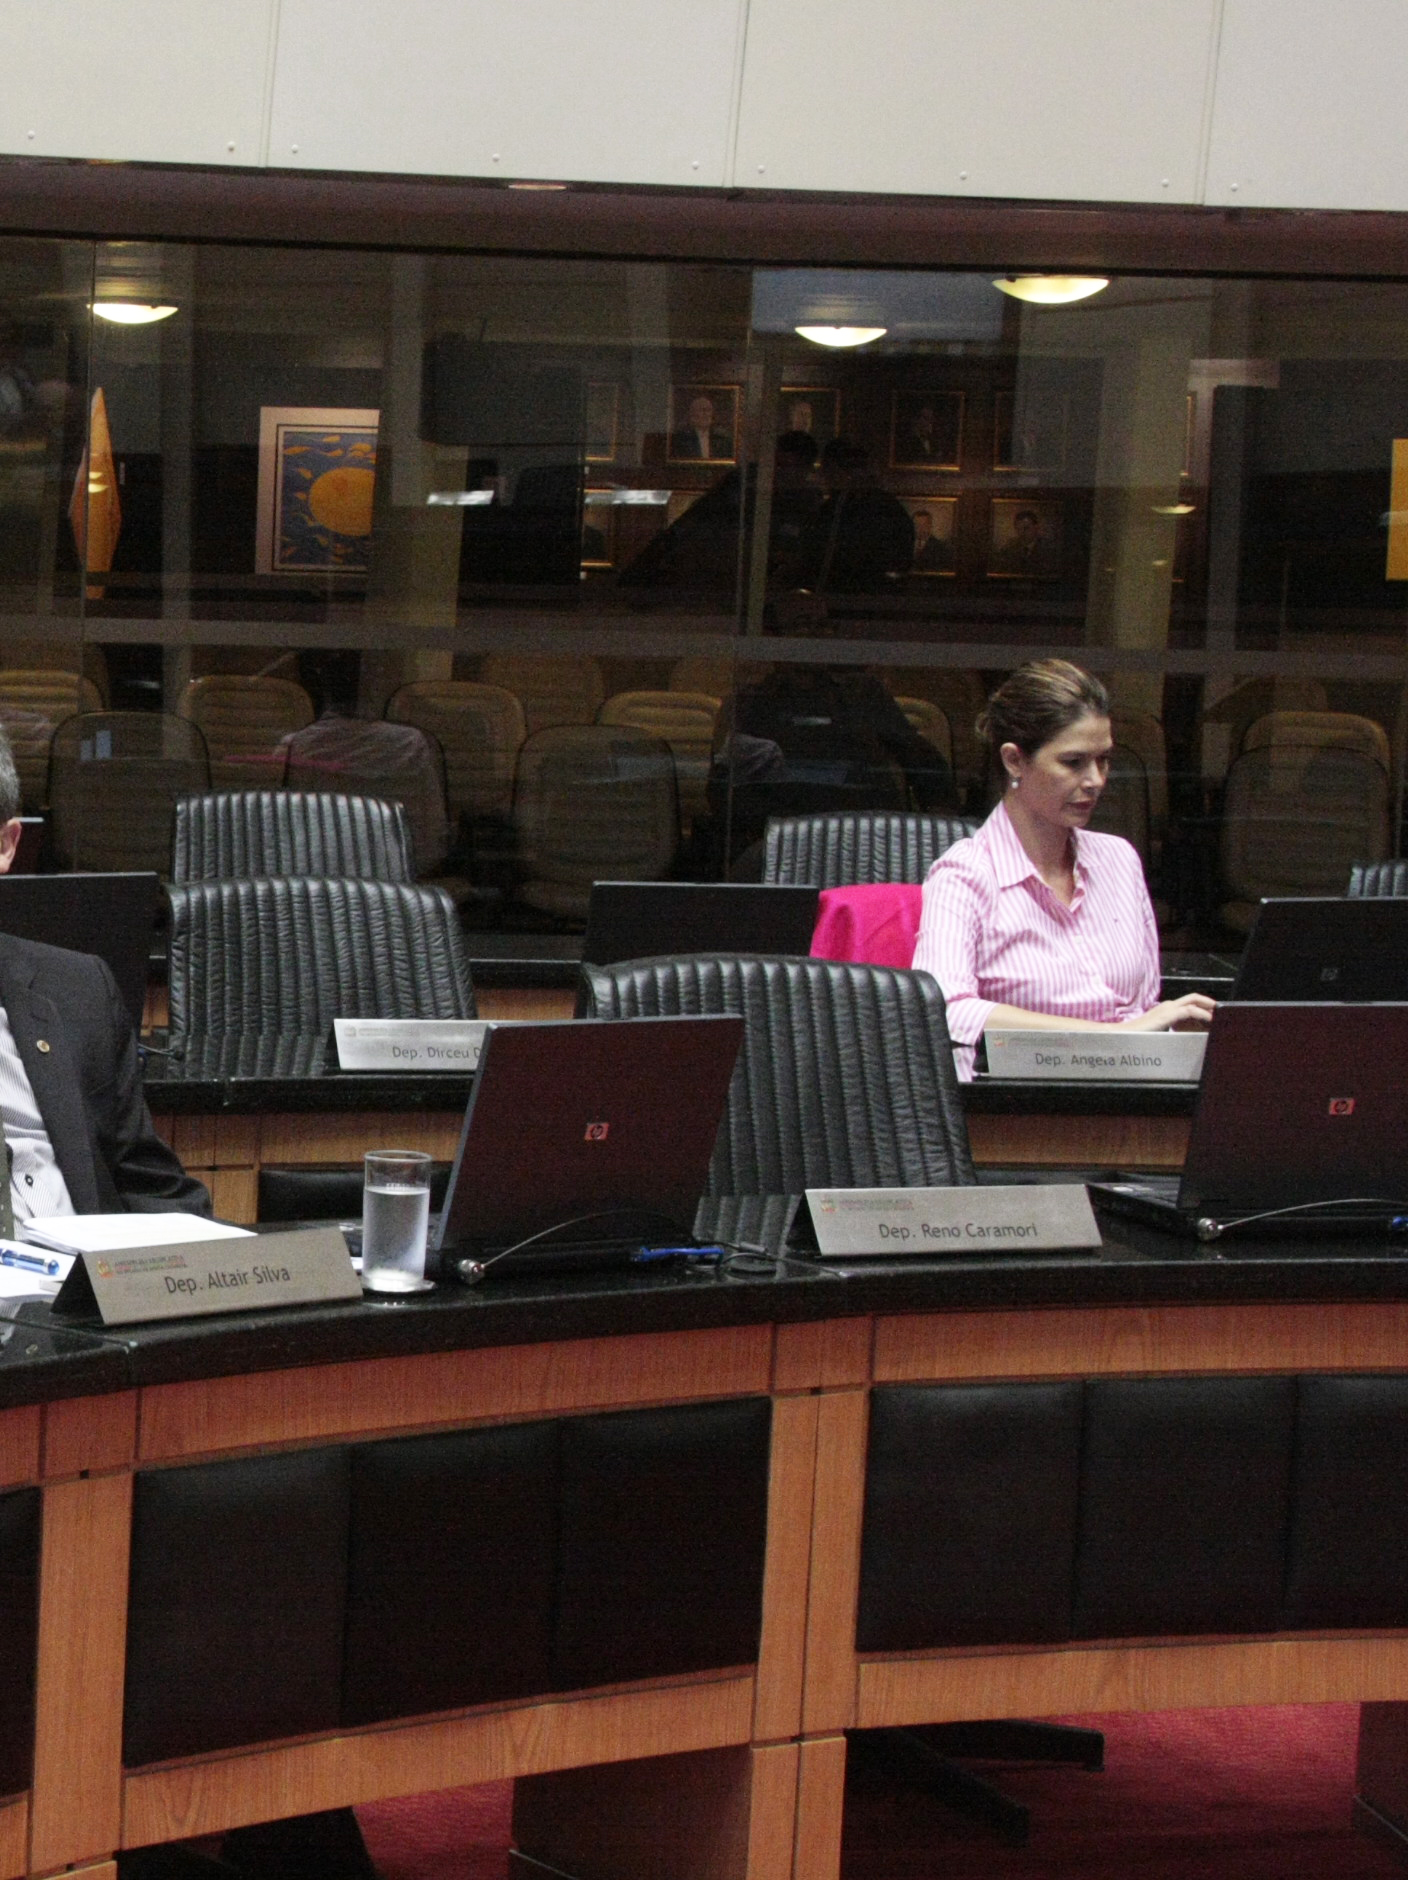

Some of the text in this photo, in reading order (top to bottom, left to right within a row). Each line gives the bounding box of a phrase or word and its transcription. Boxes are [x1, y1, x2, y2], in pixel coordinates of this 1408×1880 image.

[392, 1046, 423, 1061] Dep.
[427, 1046, 470, 1059] Dirceu
[1035, 1053, 1066, 1067] Dep.
[1120, 1054, 1163, 1067] Albino
[878, 1222, 1039, 1240] Dep. Reno Caramori
[164, 1265, 291, 1297] Dep. Altair Silva
